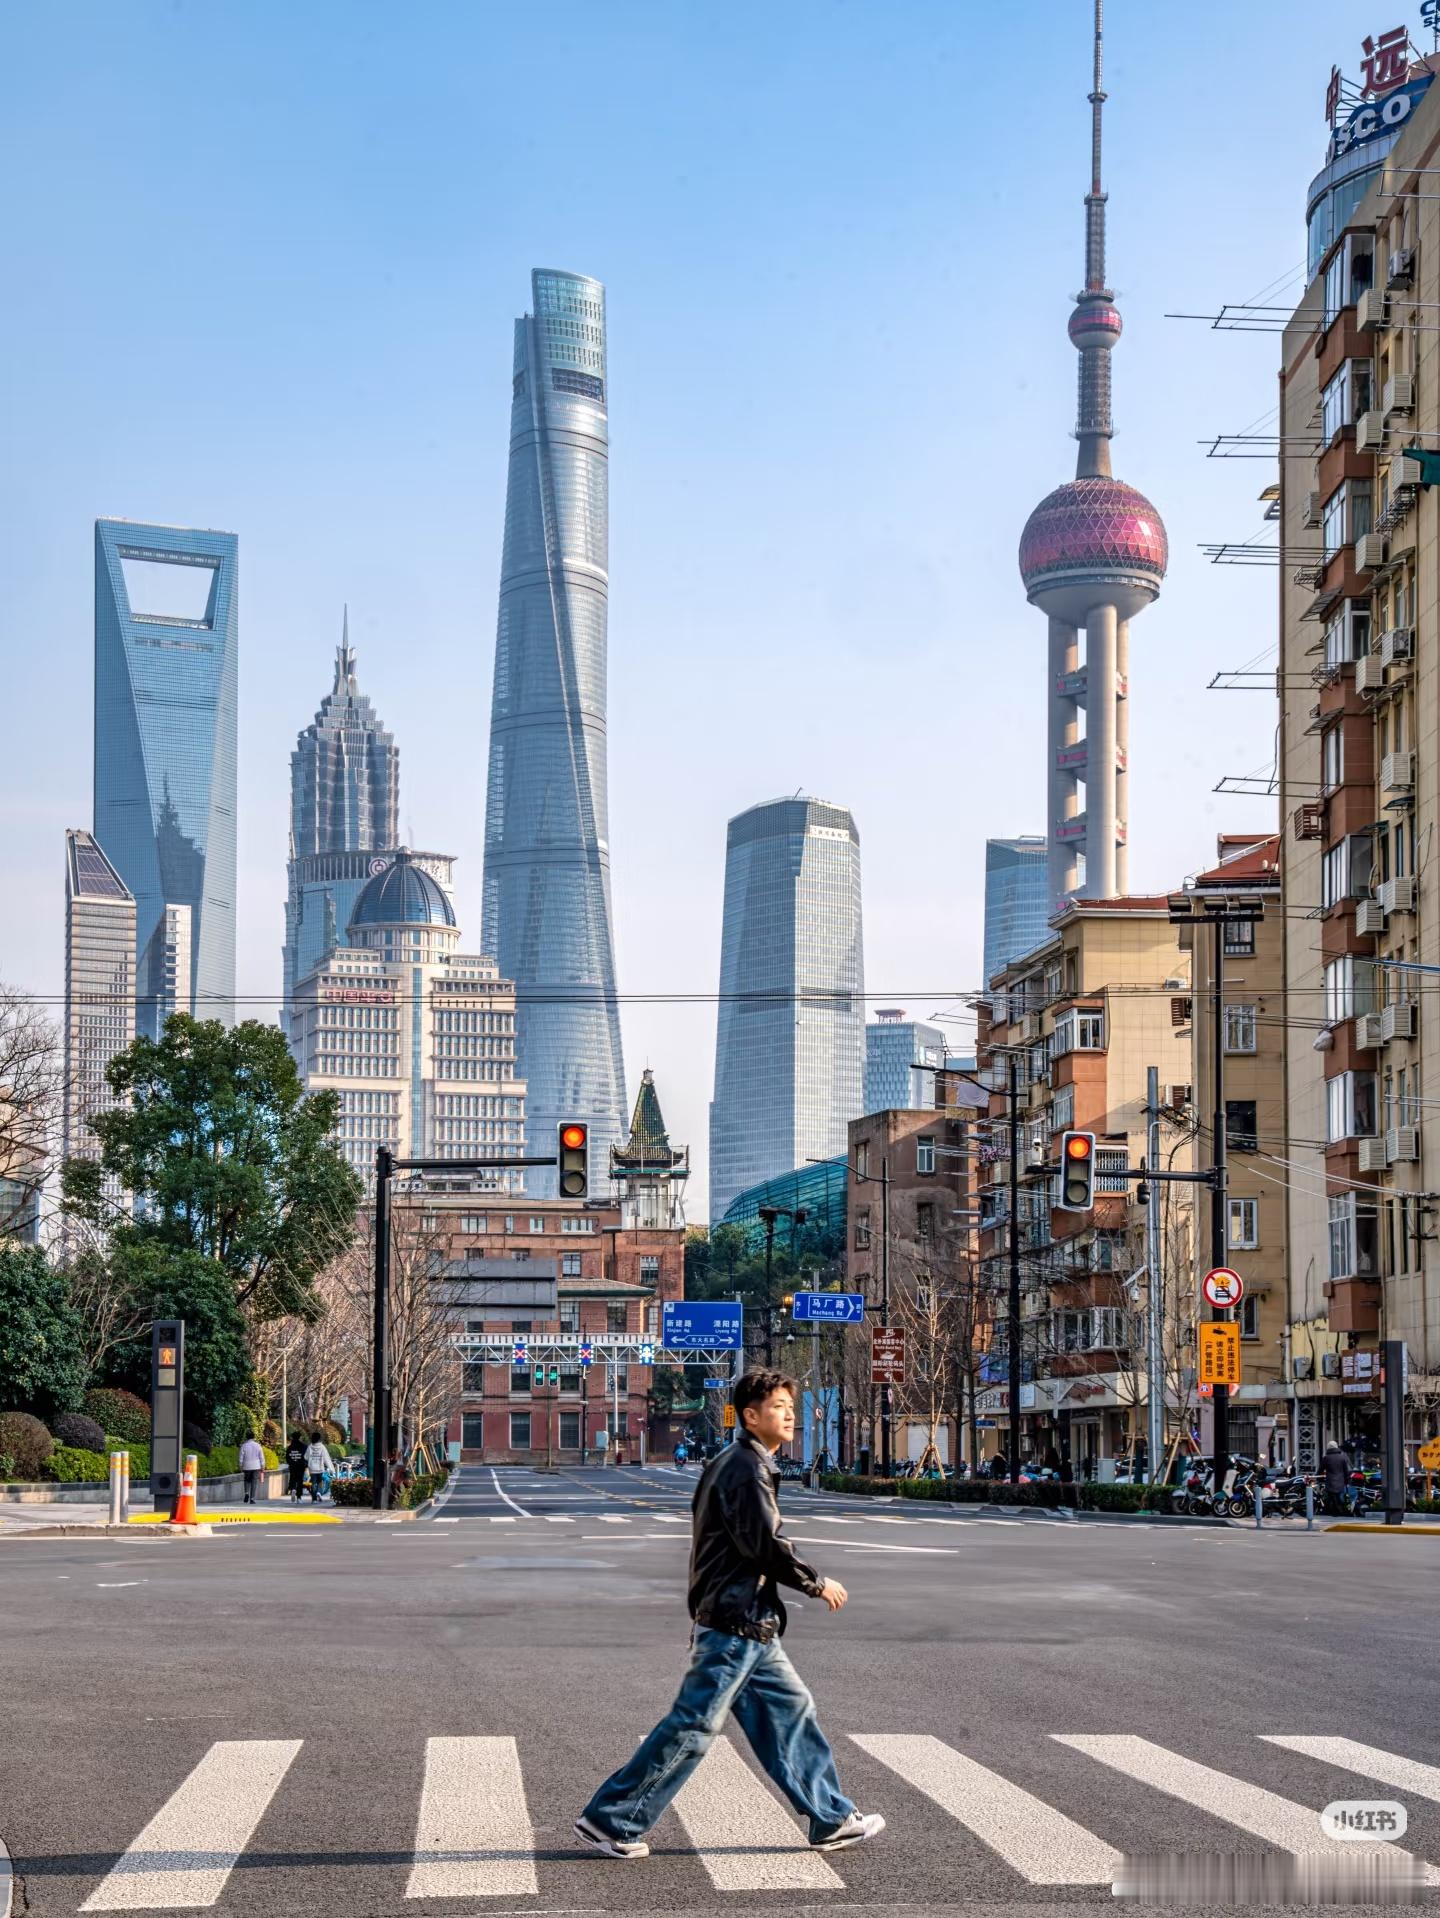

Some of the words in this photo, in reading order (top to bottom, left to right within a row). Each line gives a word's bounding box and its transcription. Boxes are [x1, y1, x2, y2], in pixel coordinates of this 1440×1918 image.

[812, 1298, 845, 1309] 马厂路
[666, 1319, 692, 1328] 新建路
[1227, 1337, 1235, 1380] 禁止违法停车
